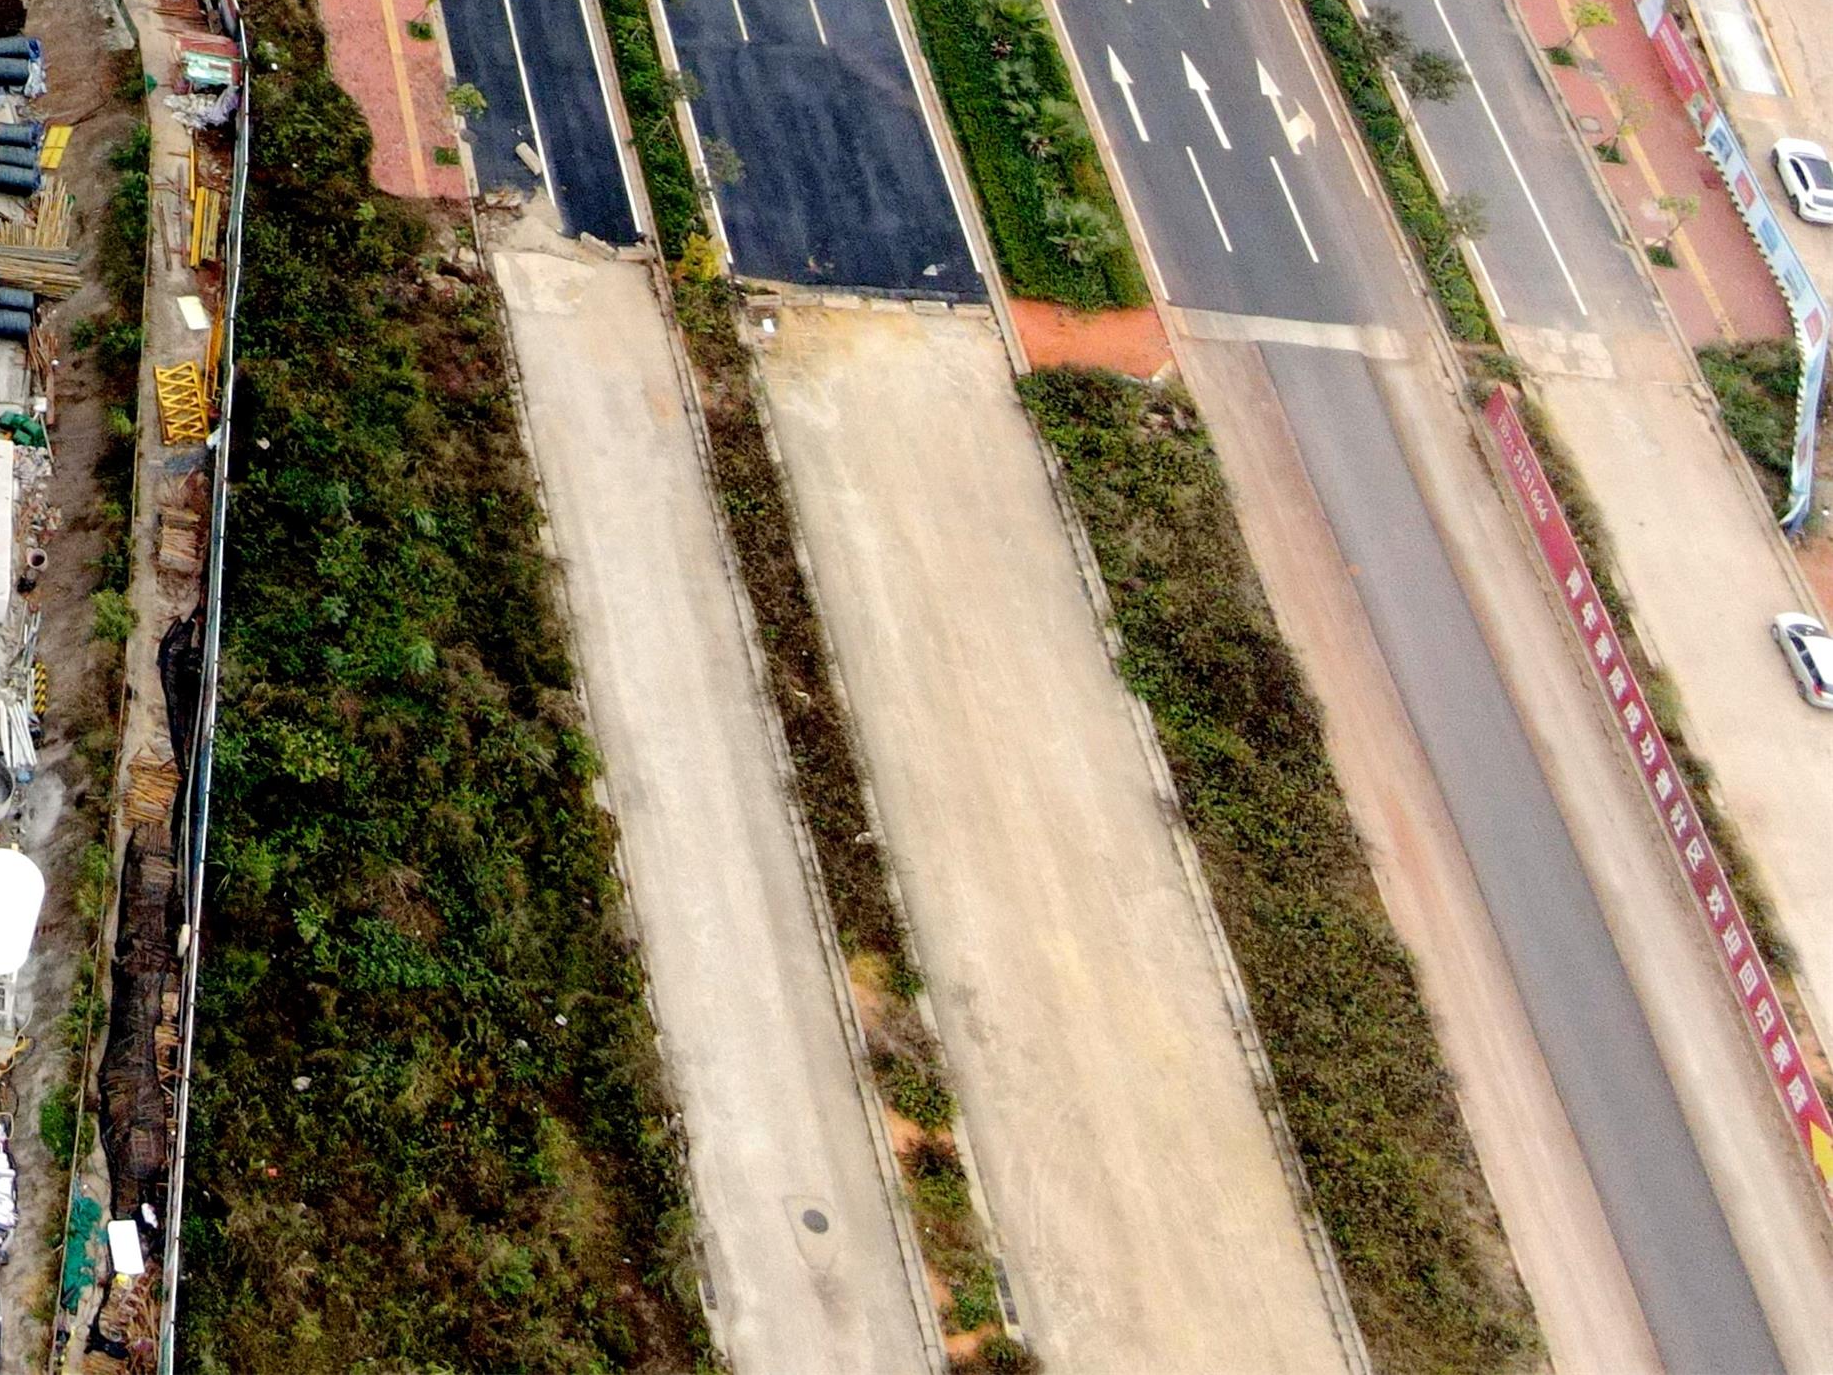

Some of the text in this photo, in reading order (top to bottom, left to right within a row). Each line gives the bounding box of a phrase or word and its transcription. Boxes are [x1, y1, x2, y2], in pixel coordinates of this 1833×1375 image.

[1705, 882, 1809, 1116] 欢迎回归家庭
